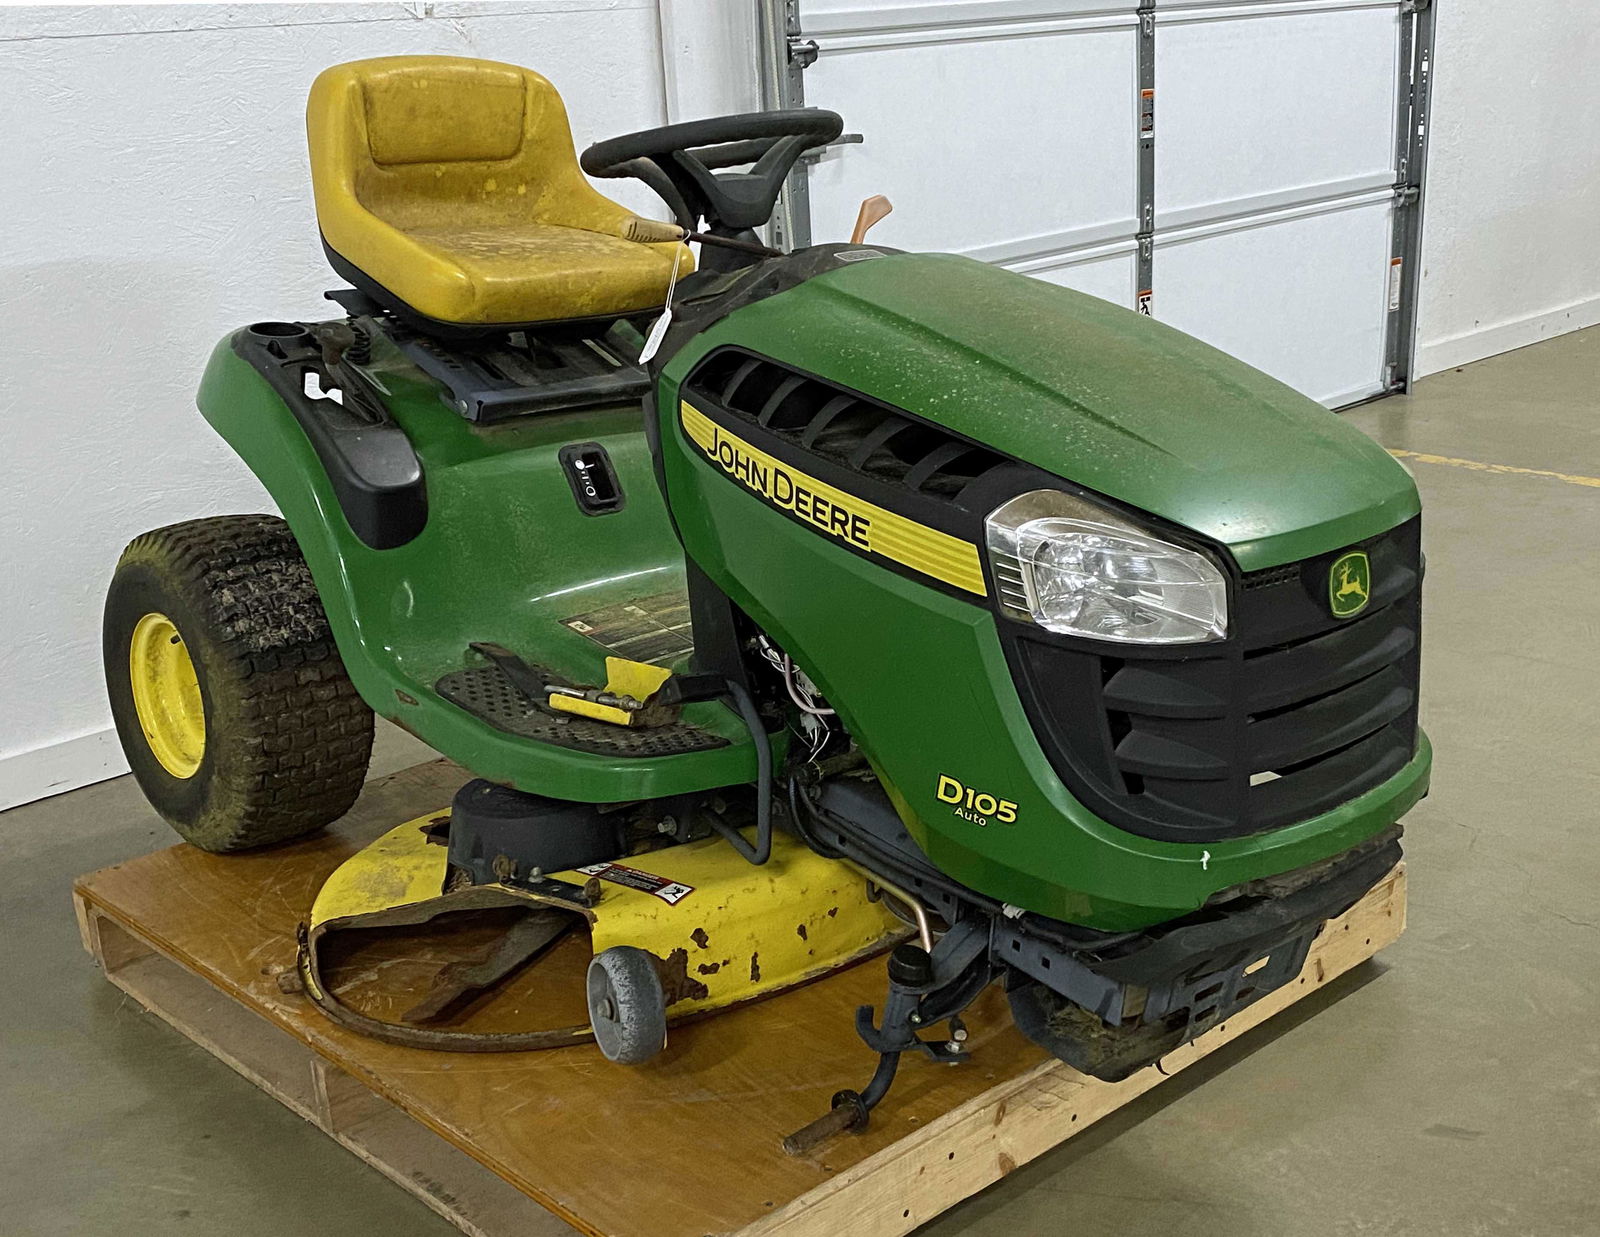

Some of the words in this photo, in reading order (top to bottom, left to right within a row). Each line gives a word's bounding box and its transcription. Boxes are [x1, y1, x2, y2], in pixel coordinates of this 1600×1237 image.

[707, 428, 768, 494] JOHN
[774, 467, 870, 547] DEERE
[937, 774, 1018, 823] D105
[954, 807, 987, 826] Auto
